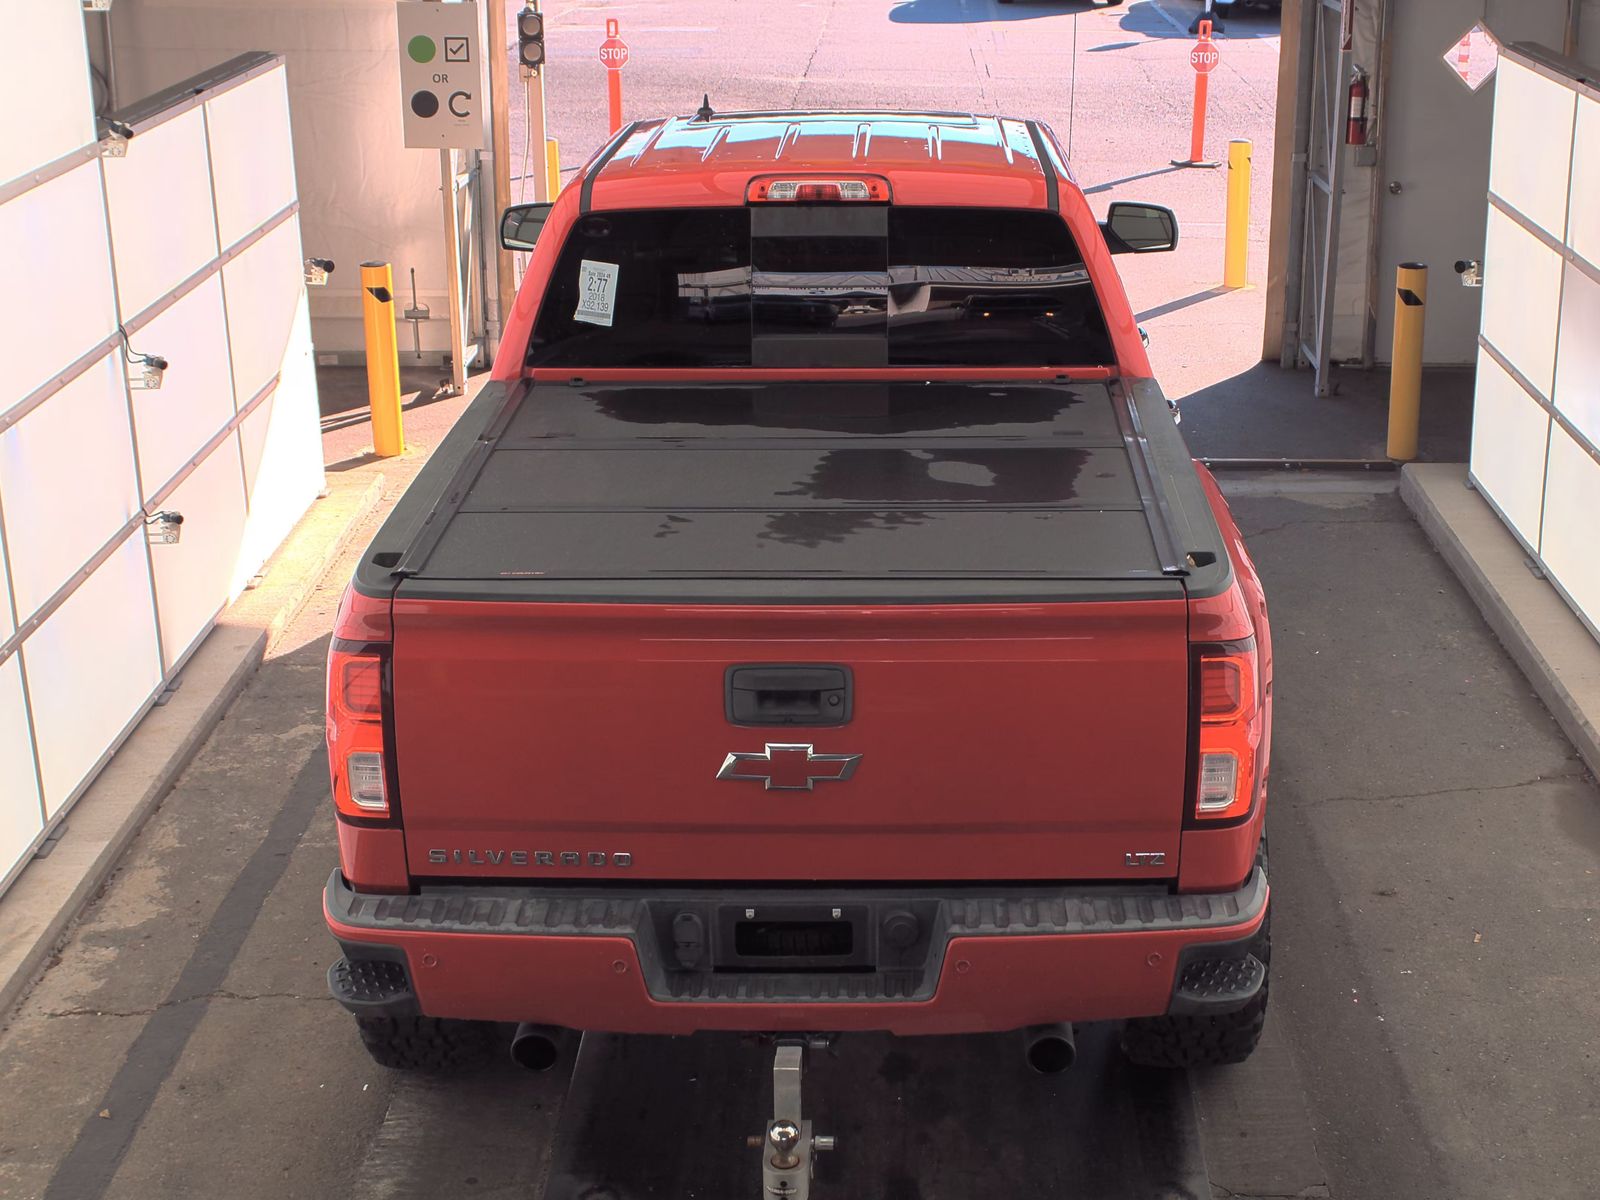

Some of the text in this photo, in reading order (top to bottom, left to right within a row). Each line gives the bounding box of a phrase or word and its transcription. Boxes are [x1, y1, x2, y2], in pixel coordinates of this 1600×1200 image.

[600, 48, 628, 60] STOP
[1191, 52, 1218, 64] STOP
[432, 73, 449, 84] OR
[428, 848, 632, 866] SILVERADO
[1125, 852, 1166, 866] LTZ
